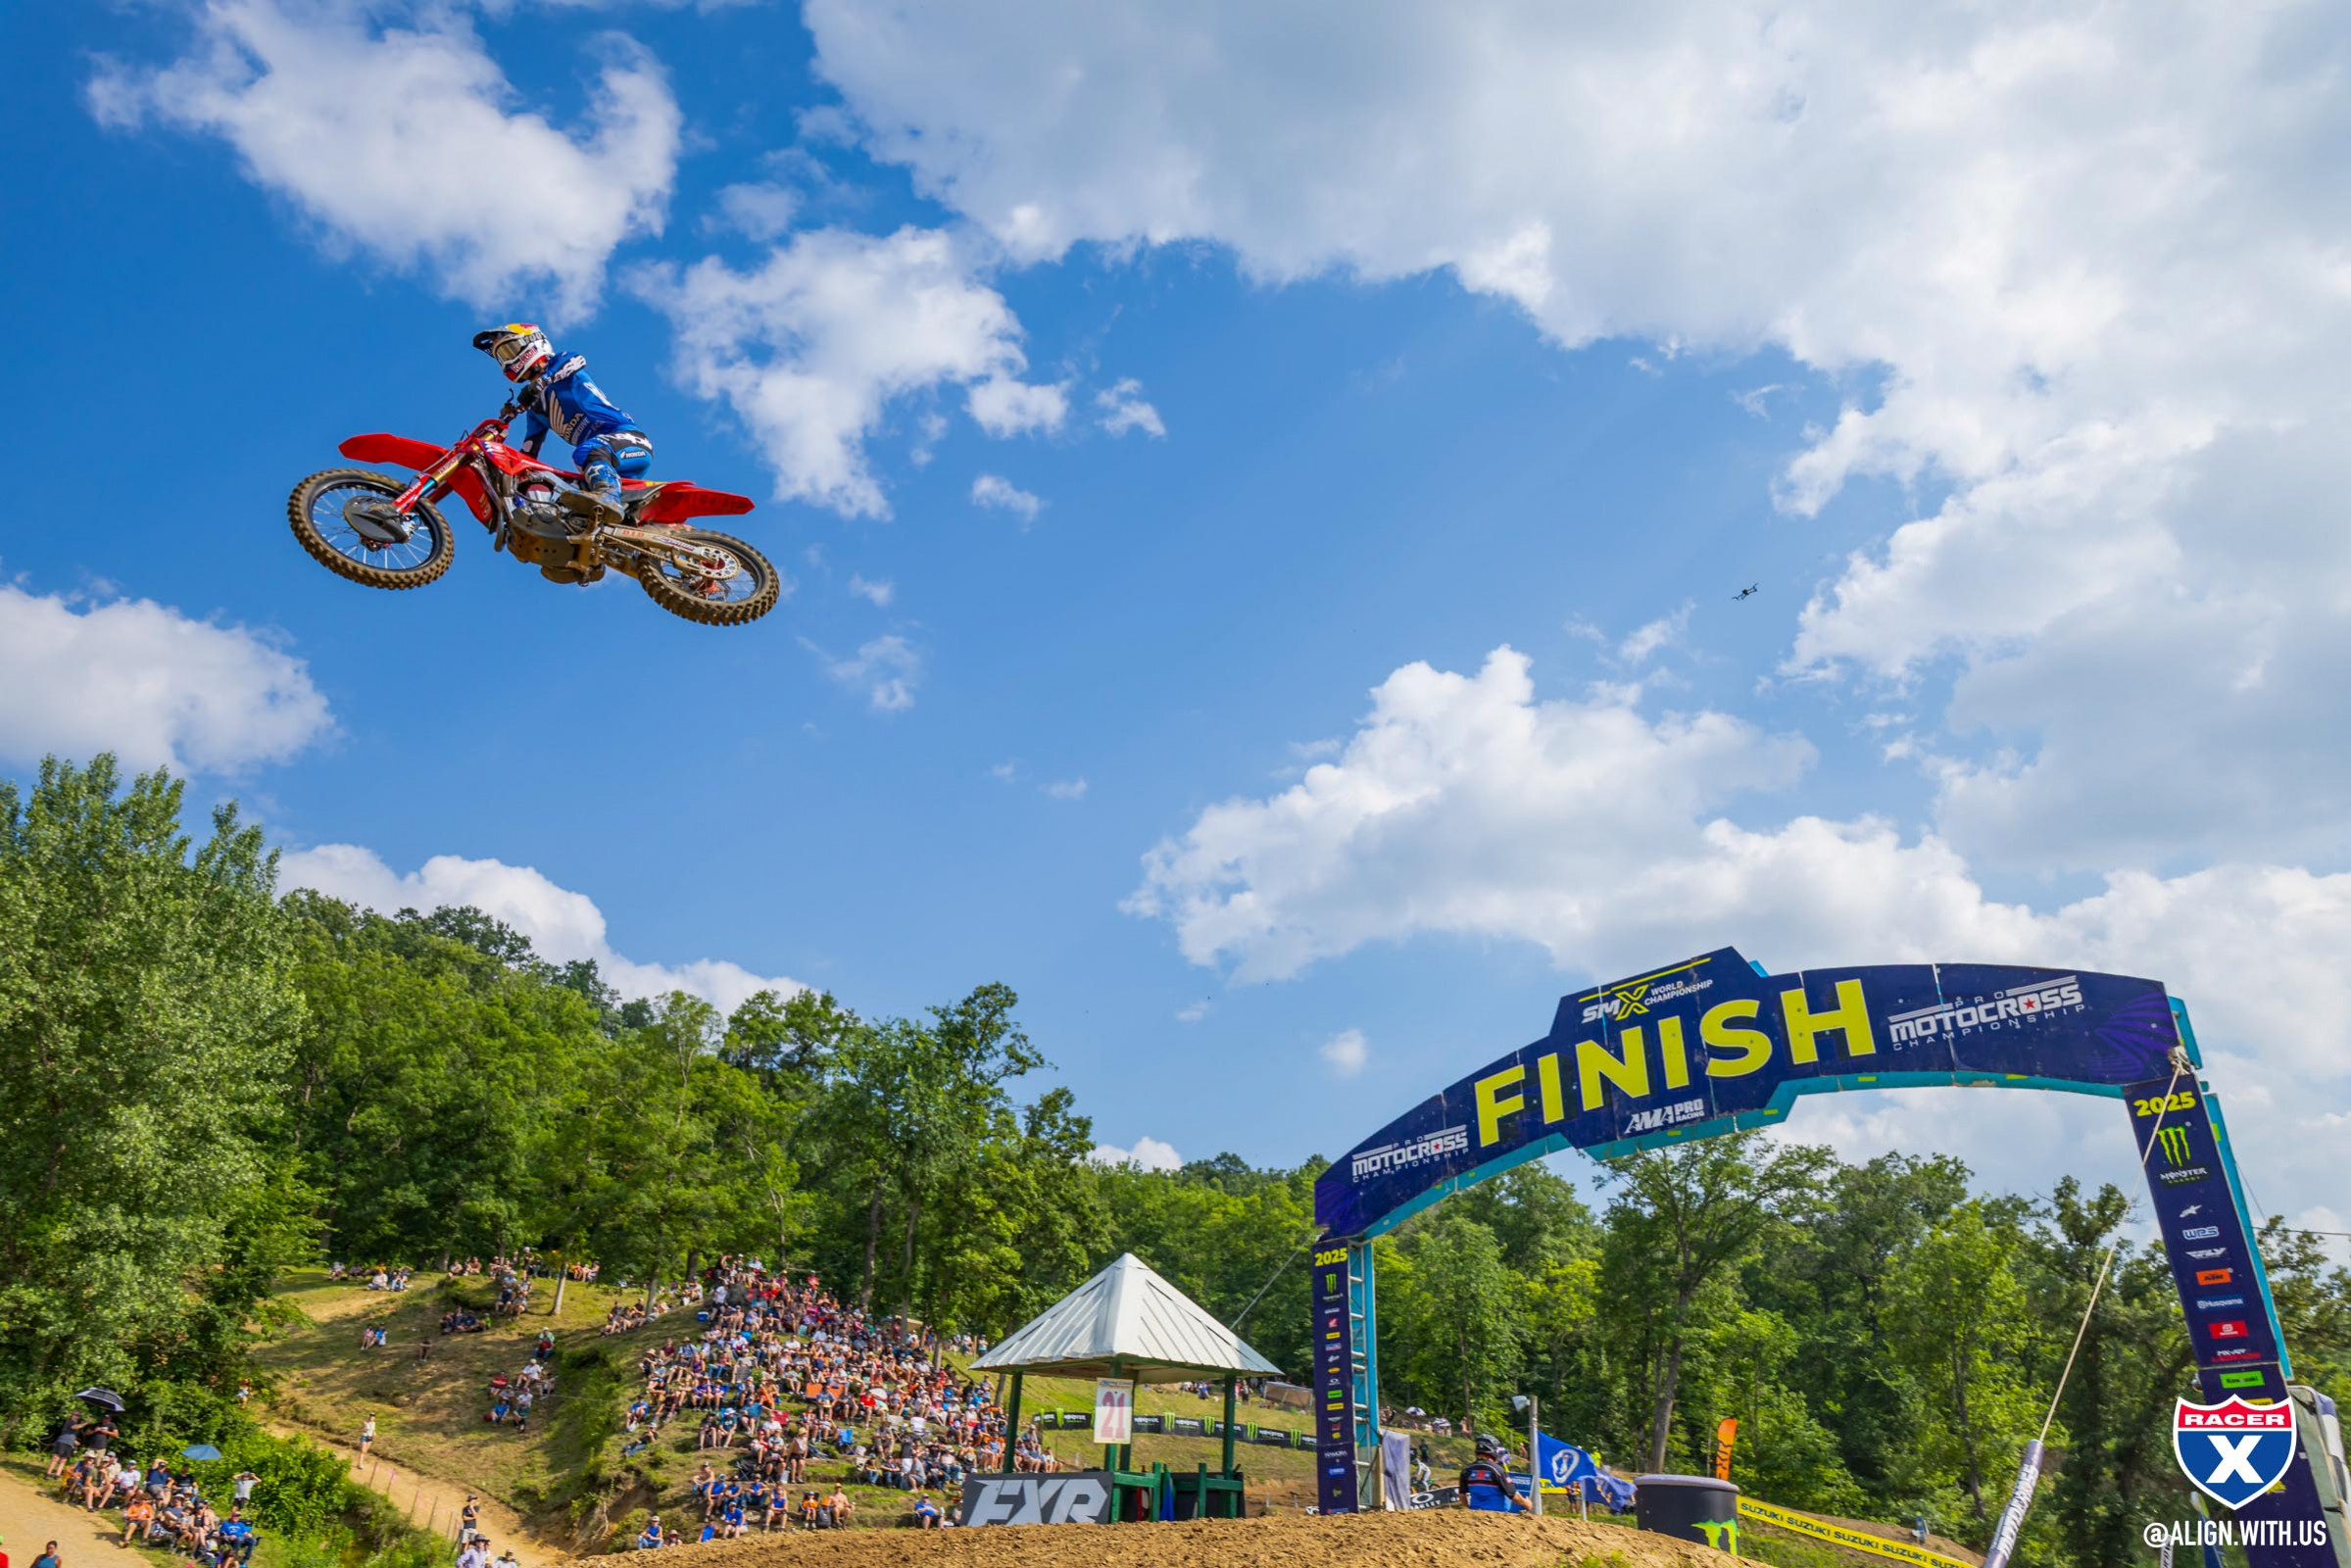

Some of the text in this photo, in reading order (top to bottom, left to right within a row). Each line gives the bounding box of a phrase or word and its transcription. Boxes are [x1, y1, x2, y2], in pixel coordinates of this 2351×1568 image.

[1581, 984, 1649, 1024] SMX
[1643, 979, 1713, 1005] CHAMPIONSHIP
[1650, 981, 1684, 996] WORLD
[1955, 992, 2003, 1008] PRO
[1889, 984, 2083, 1043] MOTOCROSS
[1893, 1004, 2085, 1051] CHAMPIONSHIP
[1474, 978, 1877, 1148] FINISH
[1624, 1099, 1703, 1134] AMA PRO
[1675, 1110, 1705, 1122] RACING
[2132, 1091, 2196, 1117] 2025
[1352, 1132, 1468, 1176] MOTOCROSS
[1394, 1136, 1423, 1149] PRO
[1352, 1148, 1469, 1183] CHAMPIONSHIP
[2160, 1167, 2208, 1181] MONSTER
[2182, 1226, 2220, 1240] WPS
[1314, 1248, 1348, 1267] 2025
[1101, 1391, 1125, 1439] 21
[966, 1478, 1109, 1527] FXR
[1740, 1502, 1784, 1521] SUZUKI
[1787, 1516, 1831, 1536] SUZUKI
[1834, 1531, 1879, 1549] SUZUKI
[1883, 1544, 1928, 1562] SUZUKI
